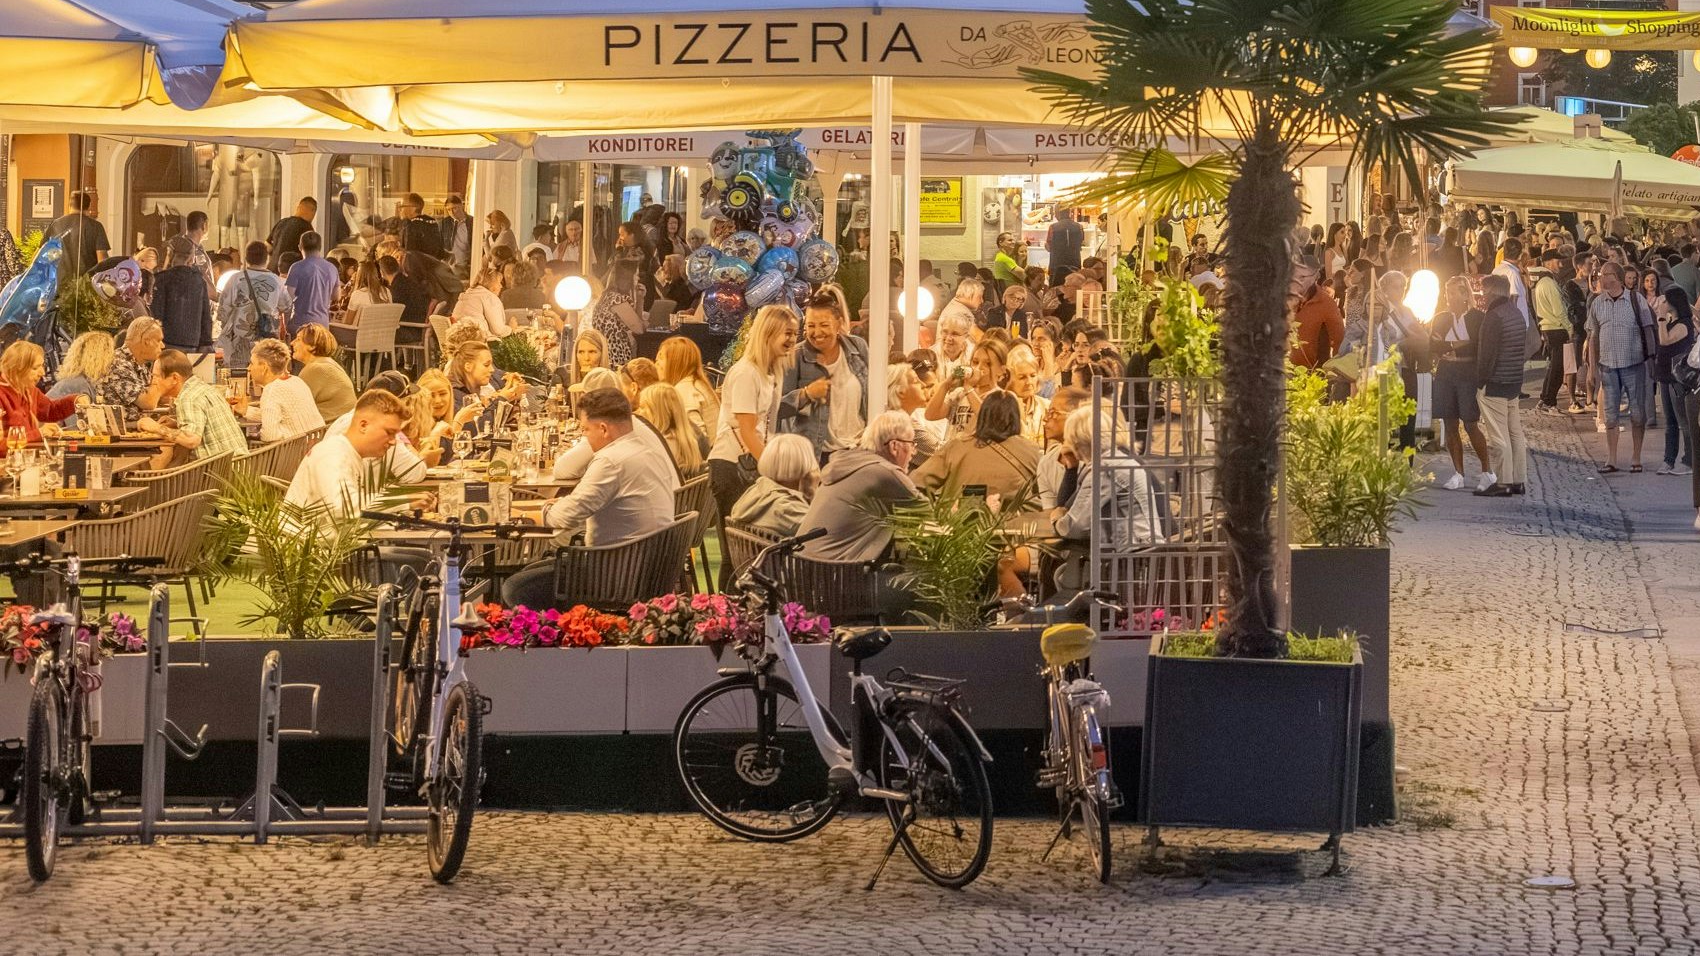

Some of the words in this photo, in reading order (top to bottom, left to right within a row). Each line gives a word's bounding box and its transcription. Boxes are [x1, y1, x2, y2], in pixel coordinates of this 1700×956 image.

[960, 26, 987, 42] DA
[1511, 15, 1597, 36] Moonlight
[604, 21, 923, 66] PIZZERIA
[588, 137, 694, 153] KONDITOREI
